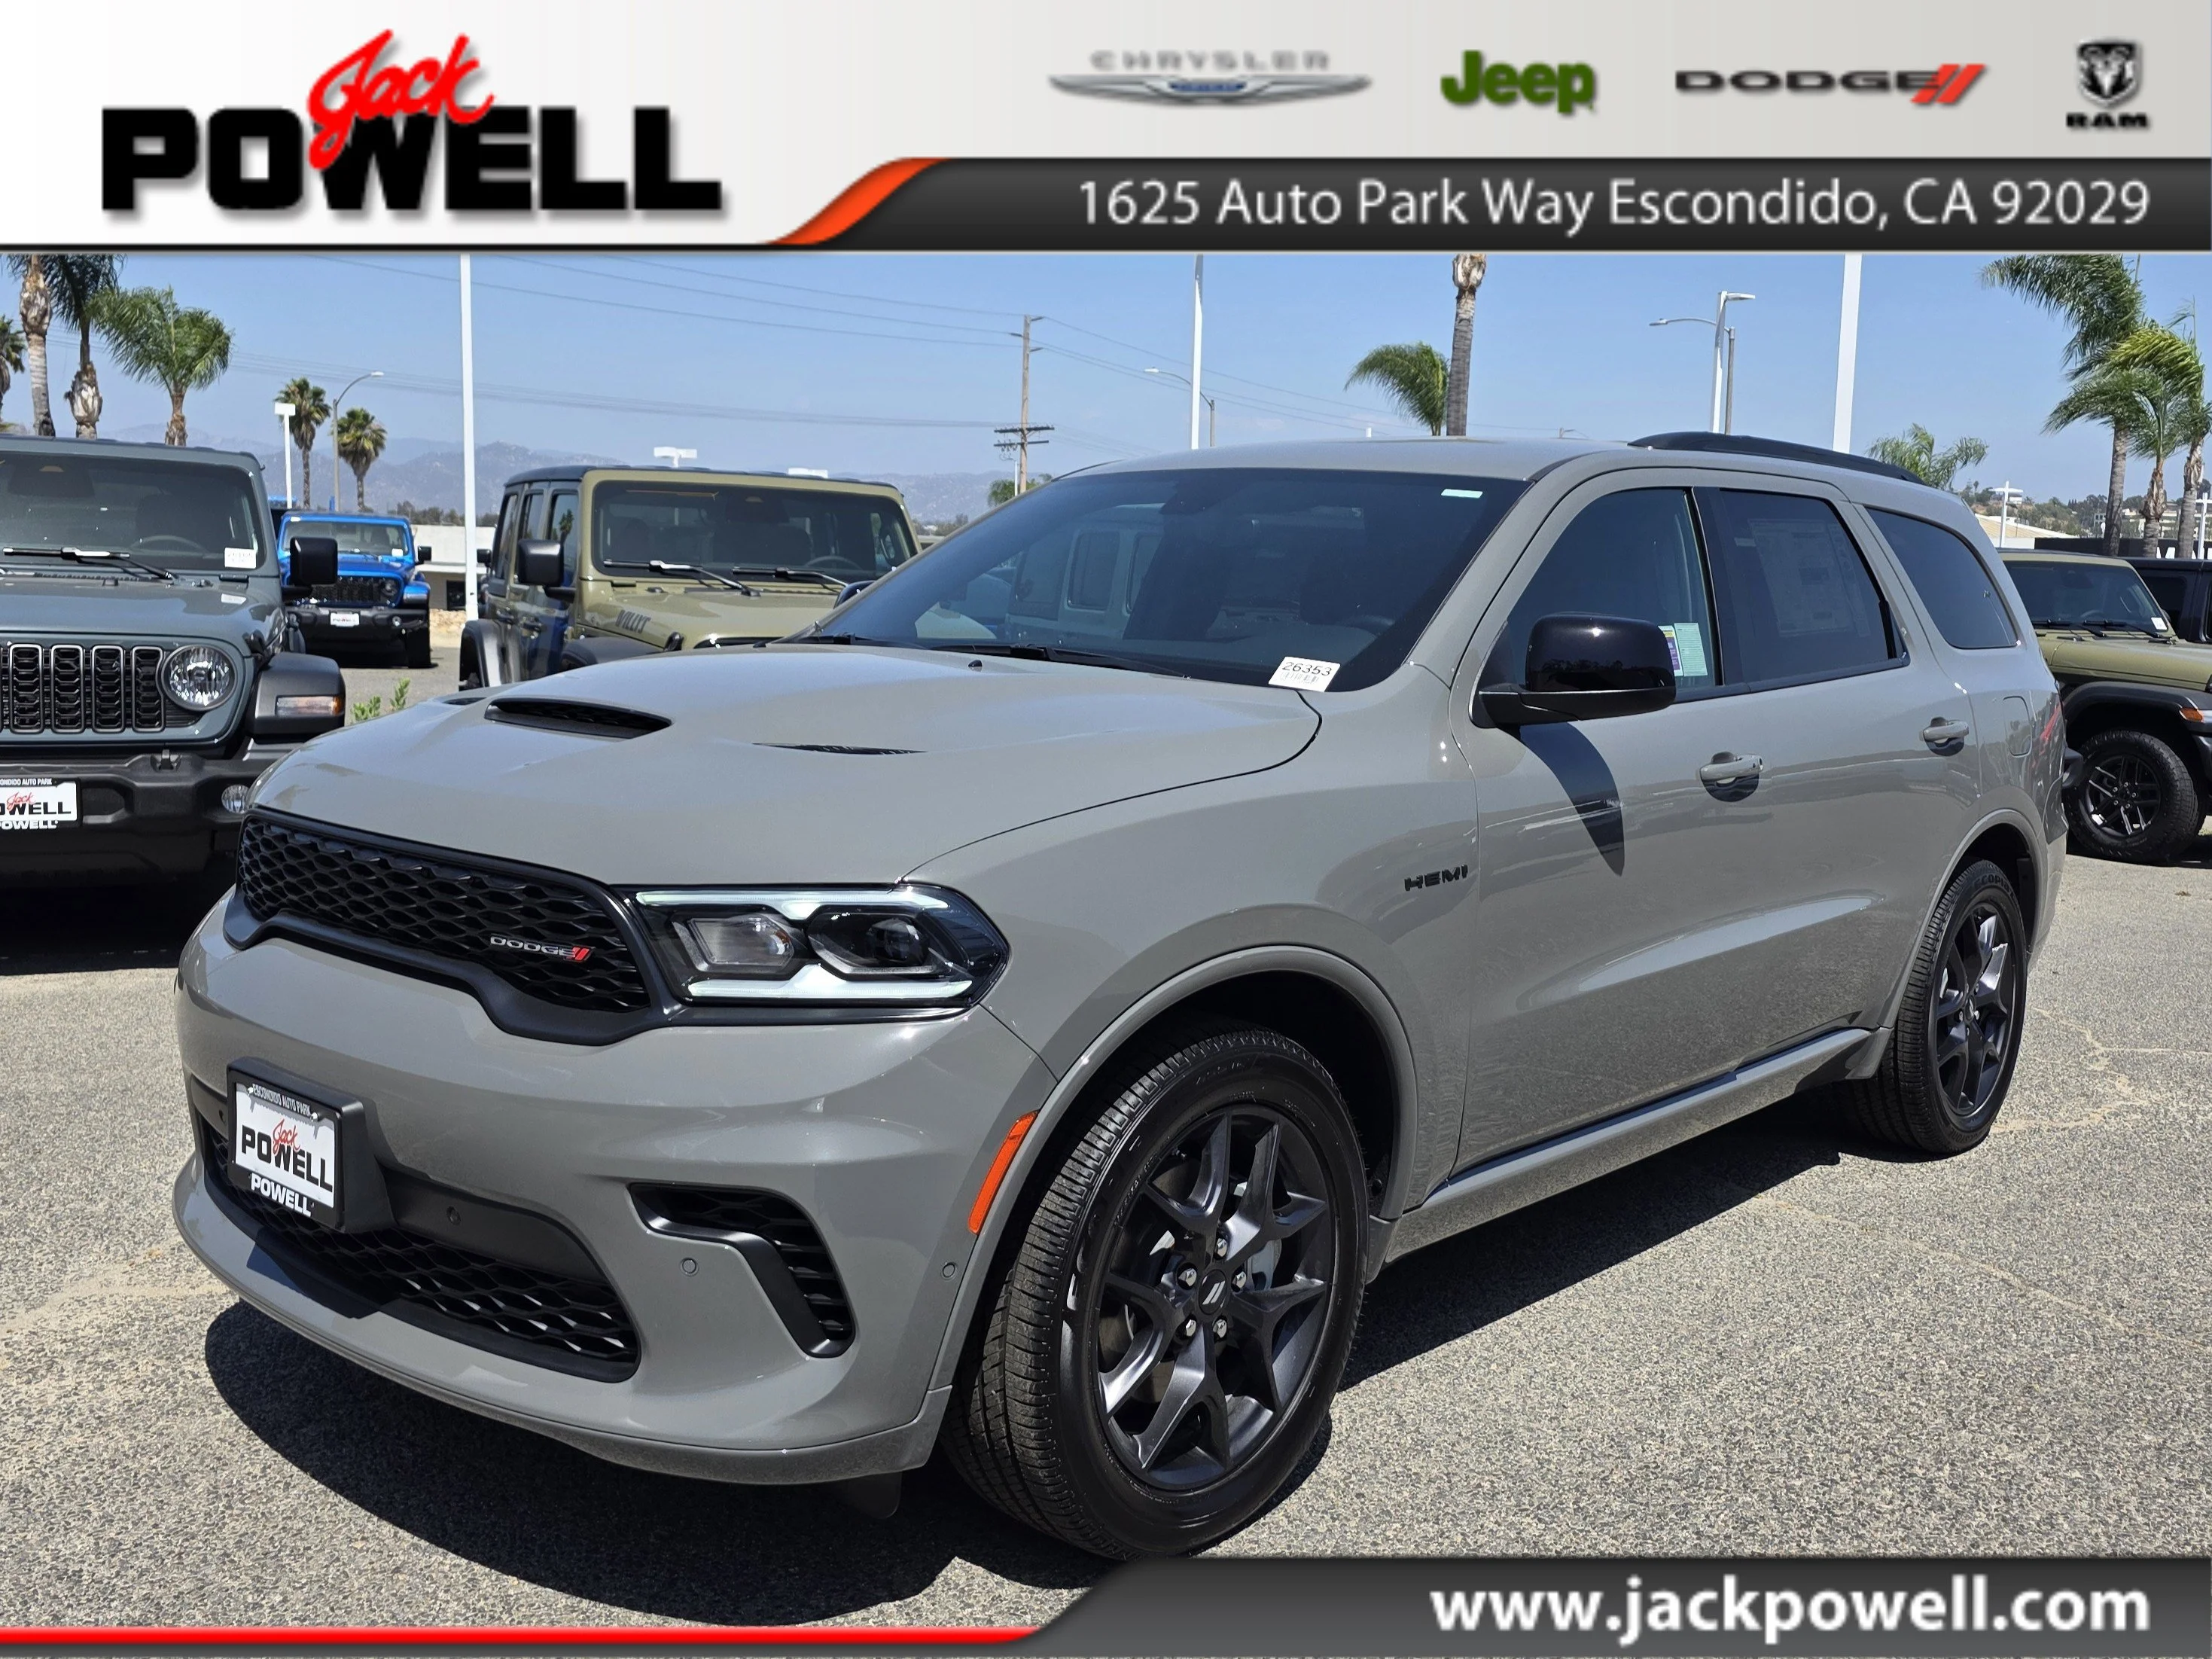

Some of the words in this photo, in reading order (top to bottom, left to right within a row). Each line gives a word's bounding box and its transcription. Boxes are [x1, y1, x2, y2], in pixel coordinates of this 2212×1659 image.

[1282, 662, 1332, 676] 26353
[38, 777, 52, 785] PARK
[0, 819, 57, 830] OWELL
[1403, 864, 1468, 892] HEMI
[490, 935, 576, 958] DODGE
[252, 1083, 282, 1106] ESCONDIDO
[282, 1094, 297, 1112] AUTO
[296, 1100, 311, 1117] PARK
[273, 1118, 300, 1156] Jack
[242, 1124, 333, 1193] POWELL
[251, 1172, 312, 1217] POWELL
